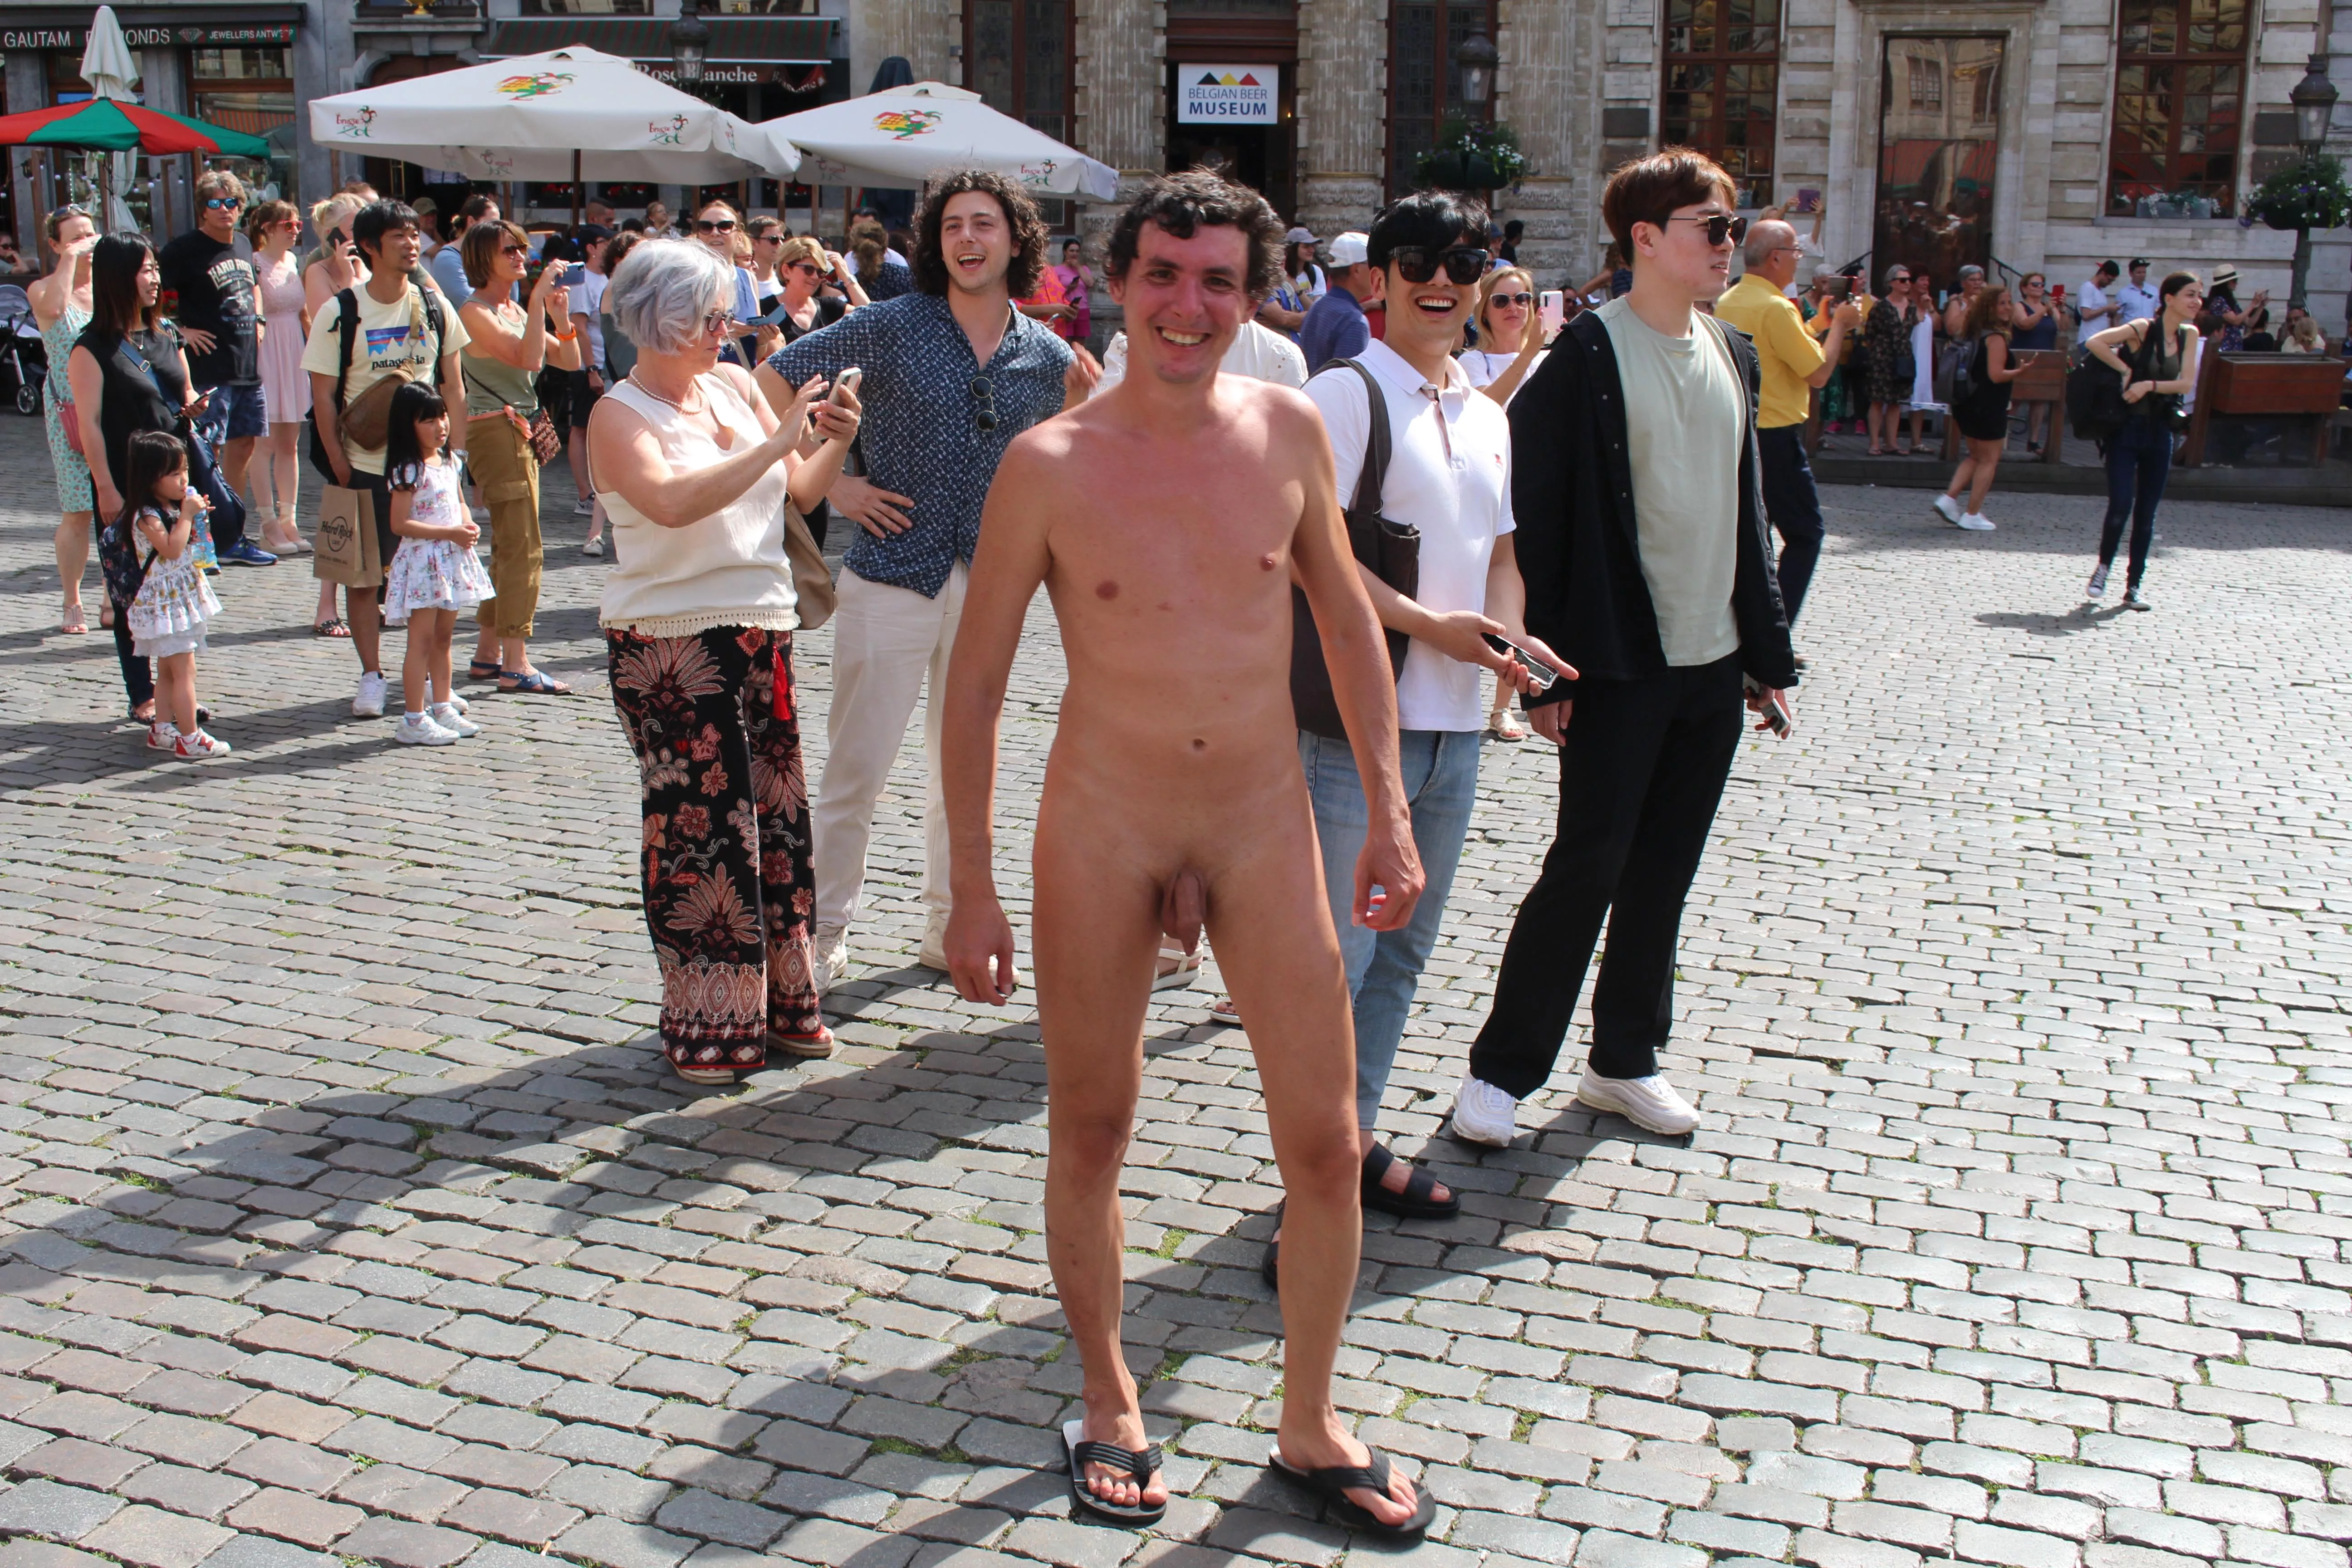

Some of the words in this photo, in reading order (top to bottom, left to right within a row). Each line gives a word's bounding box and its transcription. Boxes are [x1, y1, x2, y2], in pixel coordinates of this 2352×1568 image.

[4, 31, 71, 48] GAUTAM
[86, 29, 170, 45] ONDS
[209, 30, 254, 39] JEWELLERS
[1188, 88, 1237, 99] BELGIAN
[1240, 89, 1267, 99] BEER
[1189, 102, 1266, 115] MUSEUM
[207, 258, 236, 290] HARD
[372, 355, 425, 370] patagia
[320, 520, 340, 535] Hard
[338, 524, 353, 541] Rock
